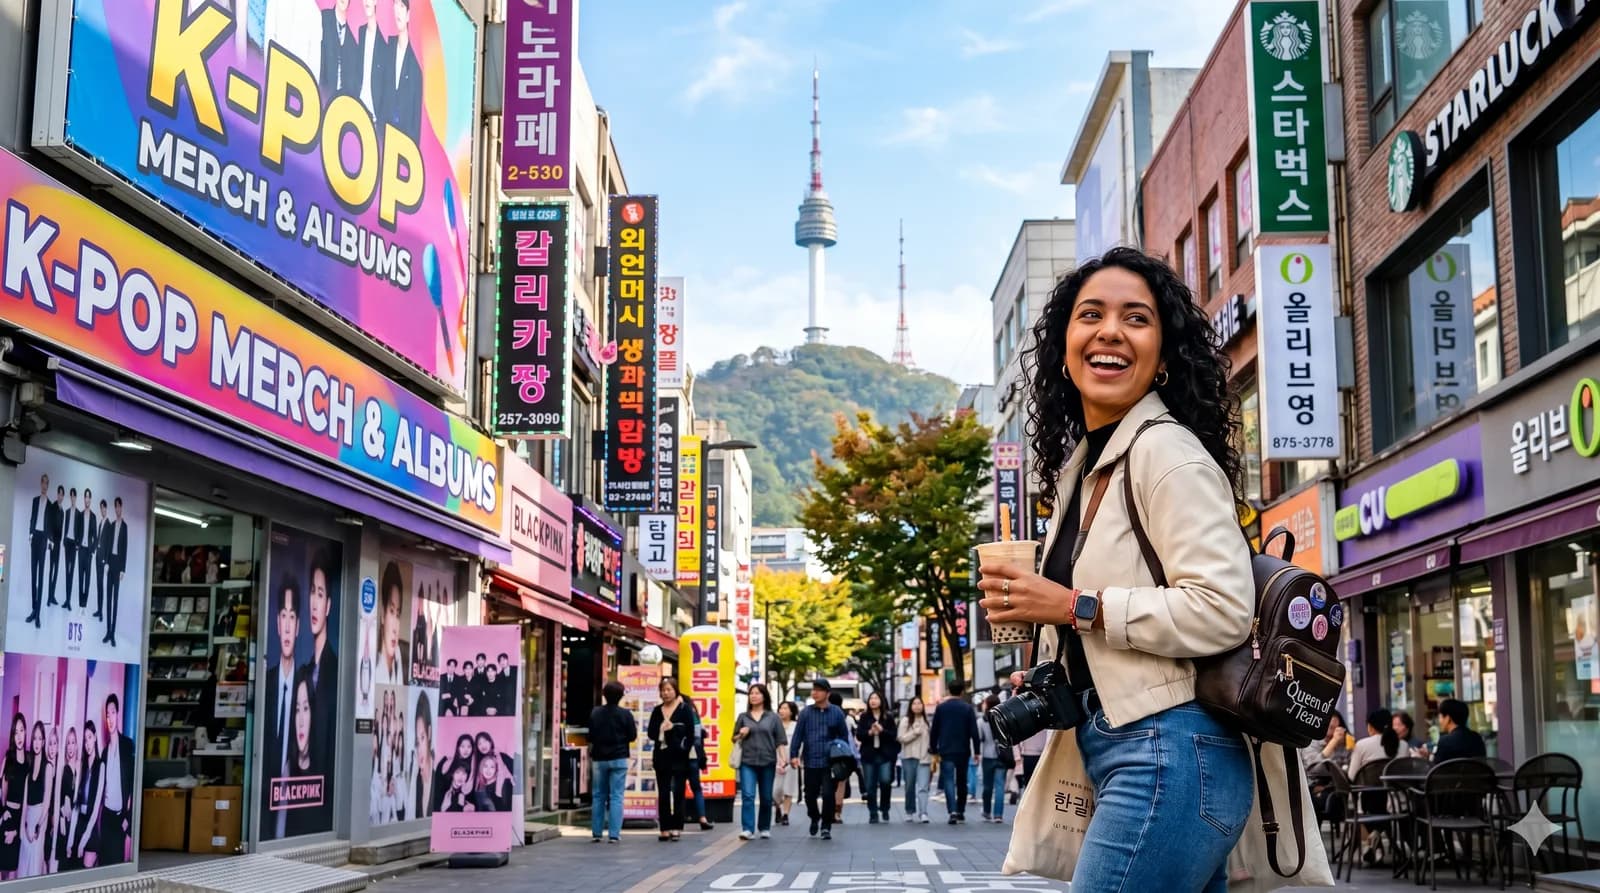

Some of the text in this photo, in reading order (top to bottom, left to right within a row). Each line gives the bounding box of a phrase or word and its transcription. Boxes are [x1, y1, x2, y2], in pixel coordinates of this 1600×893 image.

[515, 0, 560, 155] 노라페
[1425, 0, 1563, 167] STARLUCK
[149, 0, 424, 227] K-POP
[1271, 70, 1312, 222] 스타벅스
[508, 166, 563, 180] 2-530
[140, 121, 412, 287] MERCH & ALBUMS
[4, 201, 496, 512] K-POP MERCH & ALBUMS
[1284, 292, 1315, 425] 올리브영
[499, 413, 559, 425] 257-3090
[1273, 437, 1334, 448] 875-3778
[1510, 405, 1570, 474] 올리브
[514, 504, 563, 556] BLACKPINK
[1360, 486, 1384, 535] CU
[68, 622, 82, 641] BTS
[1286, 702, 1322, 728] Tears
[1287, 680, 1334, 714] Queen of
[274, 784, 320, 801] BLACKPINK
